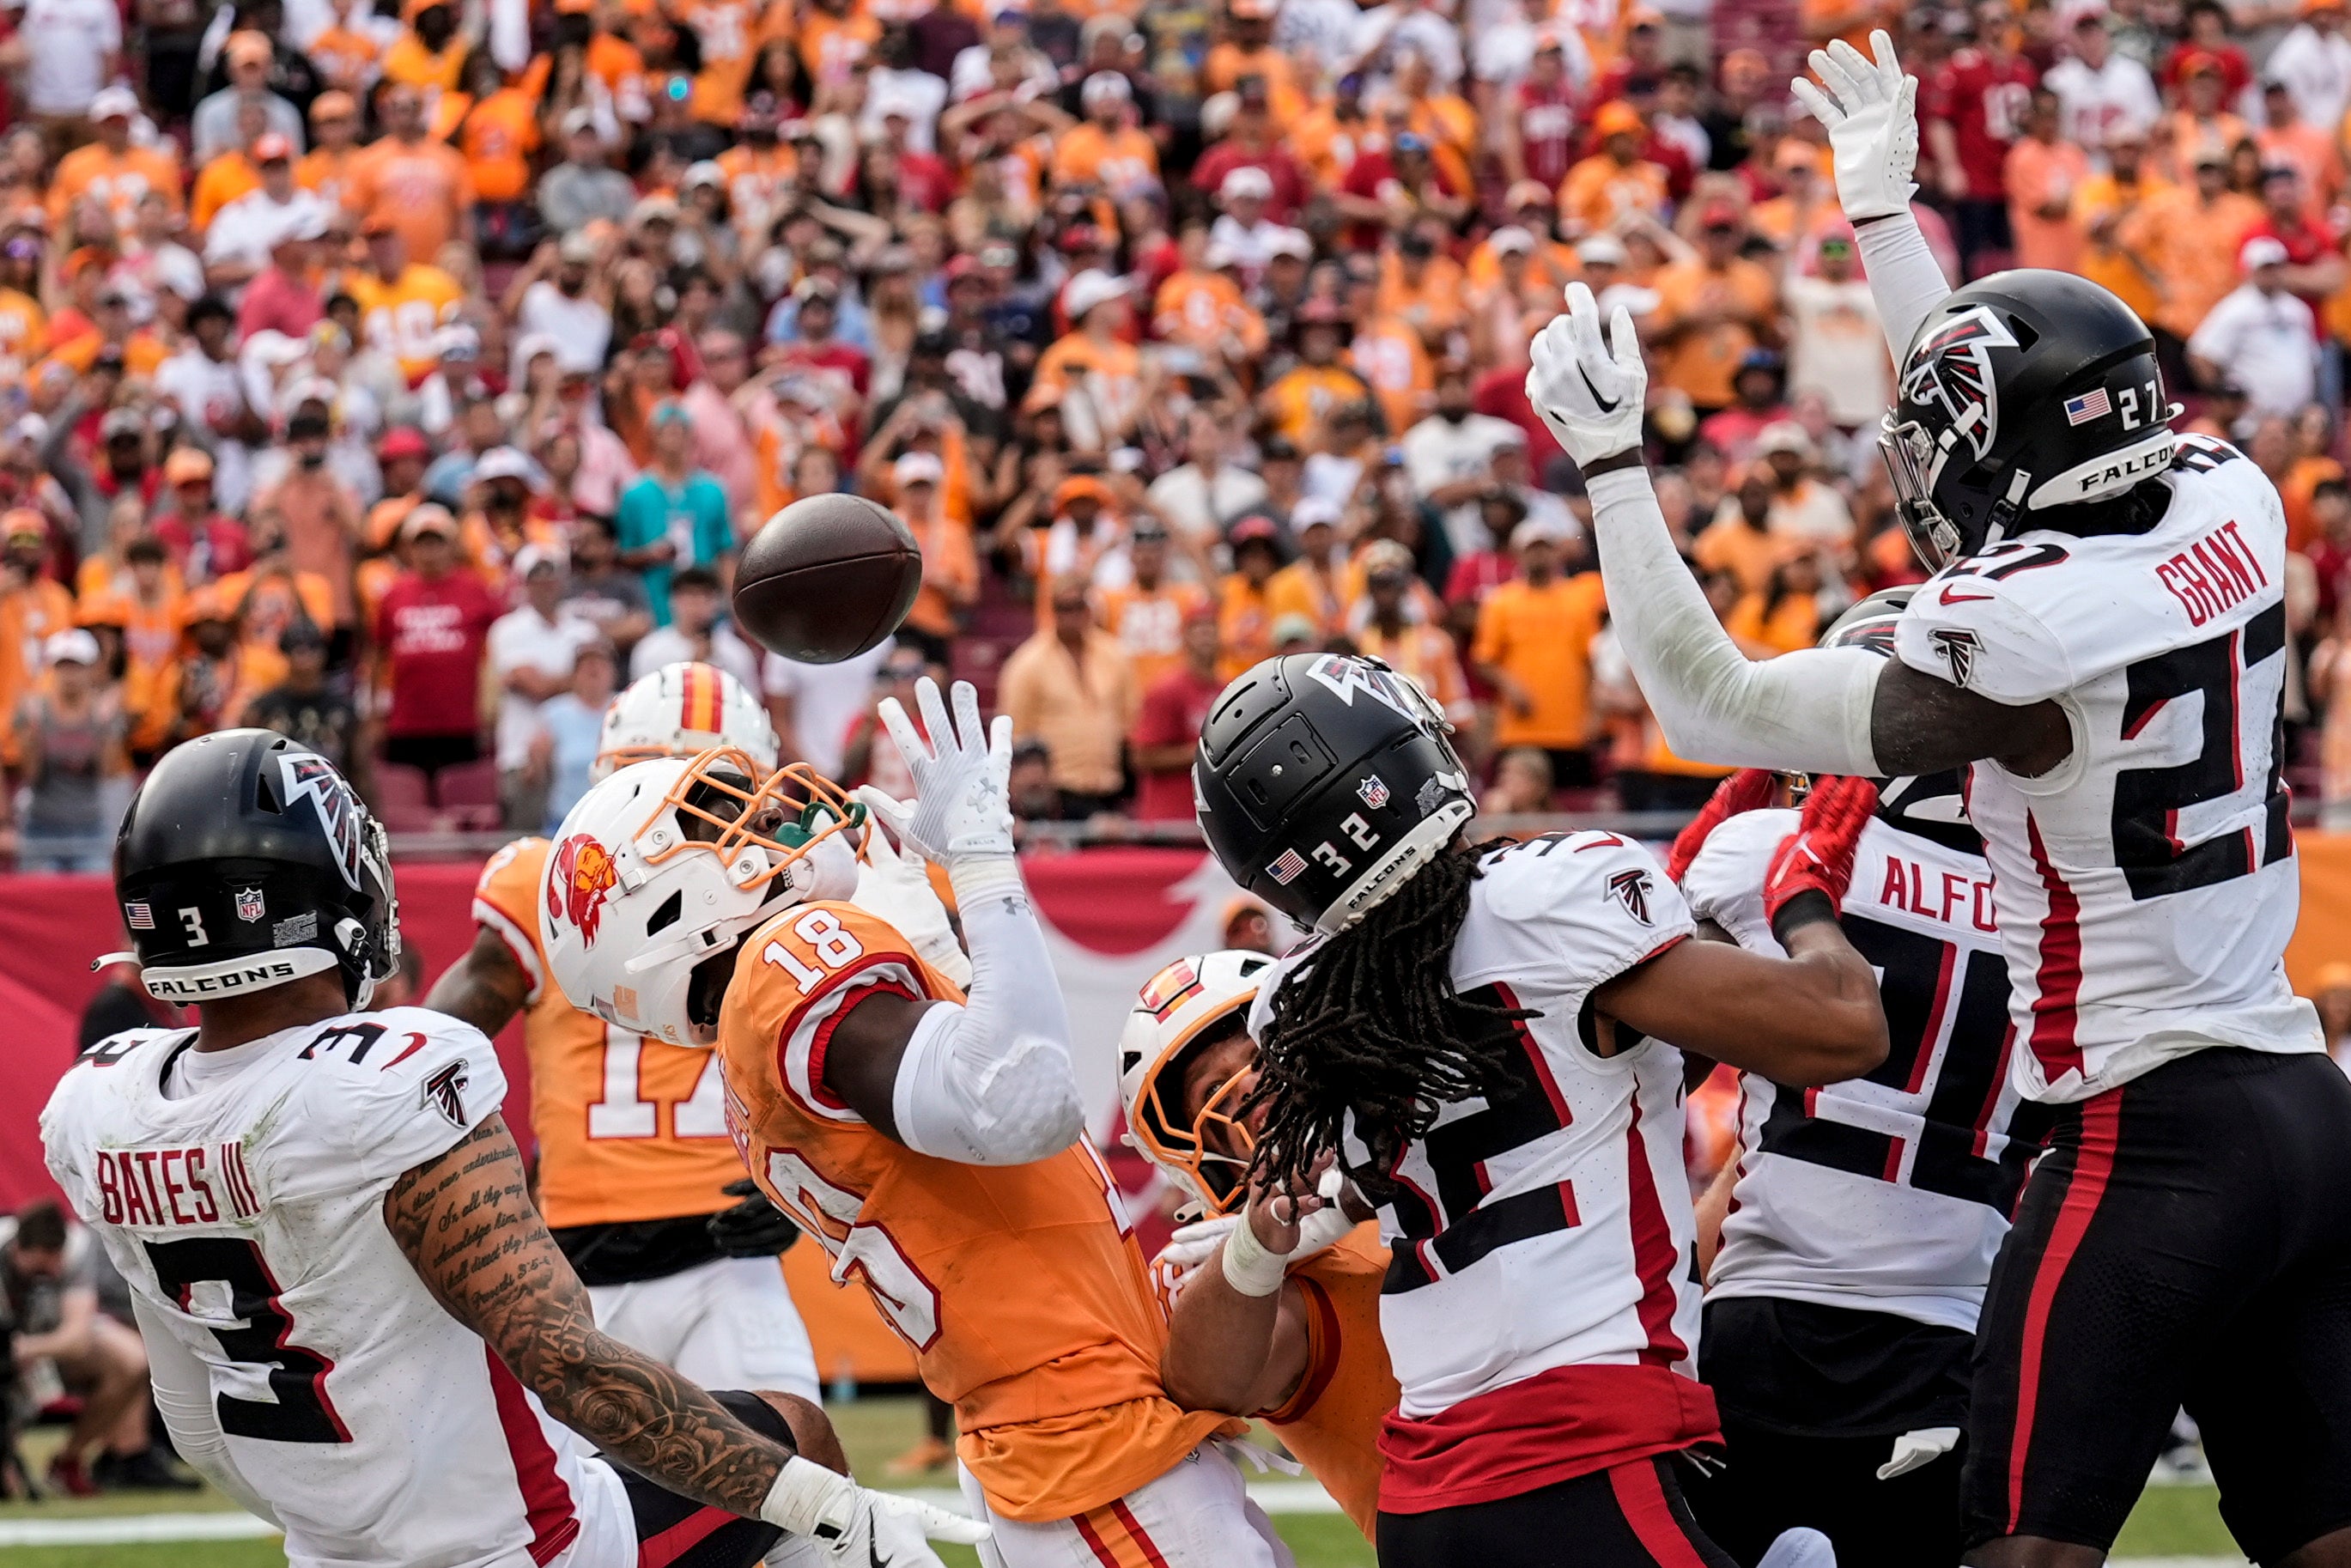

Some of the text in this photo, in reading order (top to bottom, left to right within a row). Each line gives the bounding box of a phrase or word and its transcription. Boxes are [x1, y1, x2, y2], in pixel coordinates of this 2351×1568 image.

[2118, 379, 2158, 430] 27
[1939, 544, 2070, 580] 27
[2155, 520, 2269, 627] GRANT
[1310, 811, 1381, 878] 32
[1347, 845, 1417, 909] FALCONS
[178, 906, 210, 947] 3
[241, 903, 263, 917] NFL
[147, 962, 295, 996] FALCONS
[763, 908, 865, 996] 18
[96, 1140, 261, 1225] BATES III
[462, 1189, 481, 1217] all
[143, 1237, 354, 1443] 3
